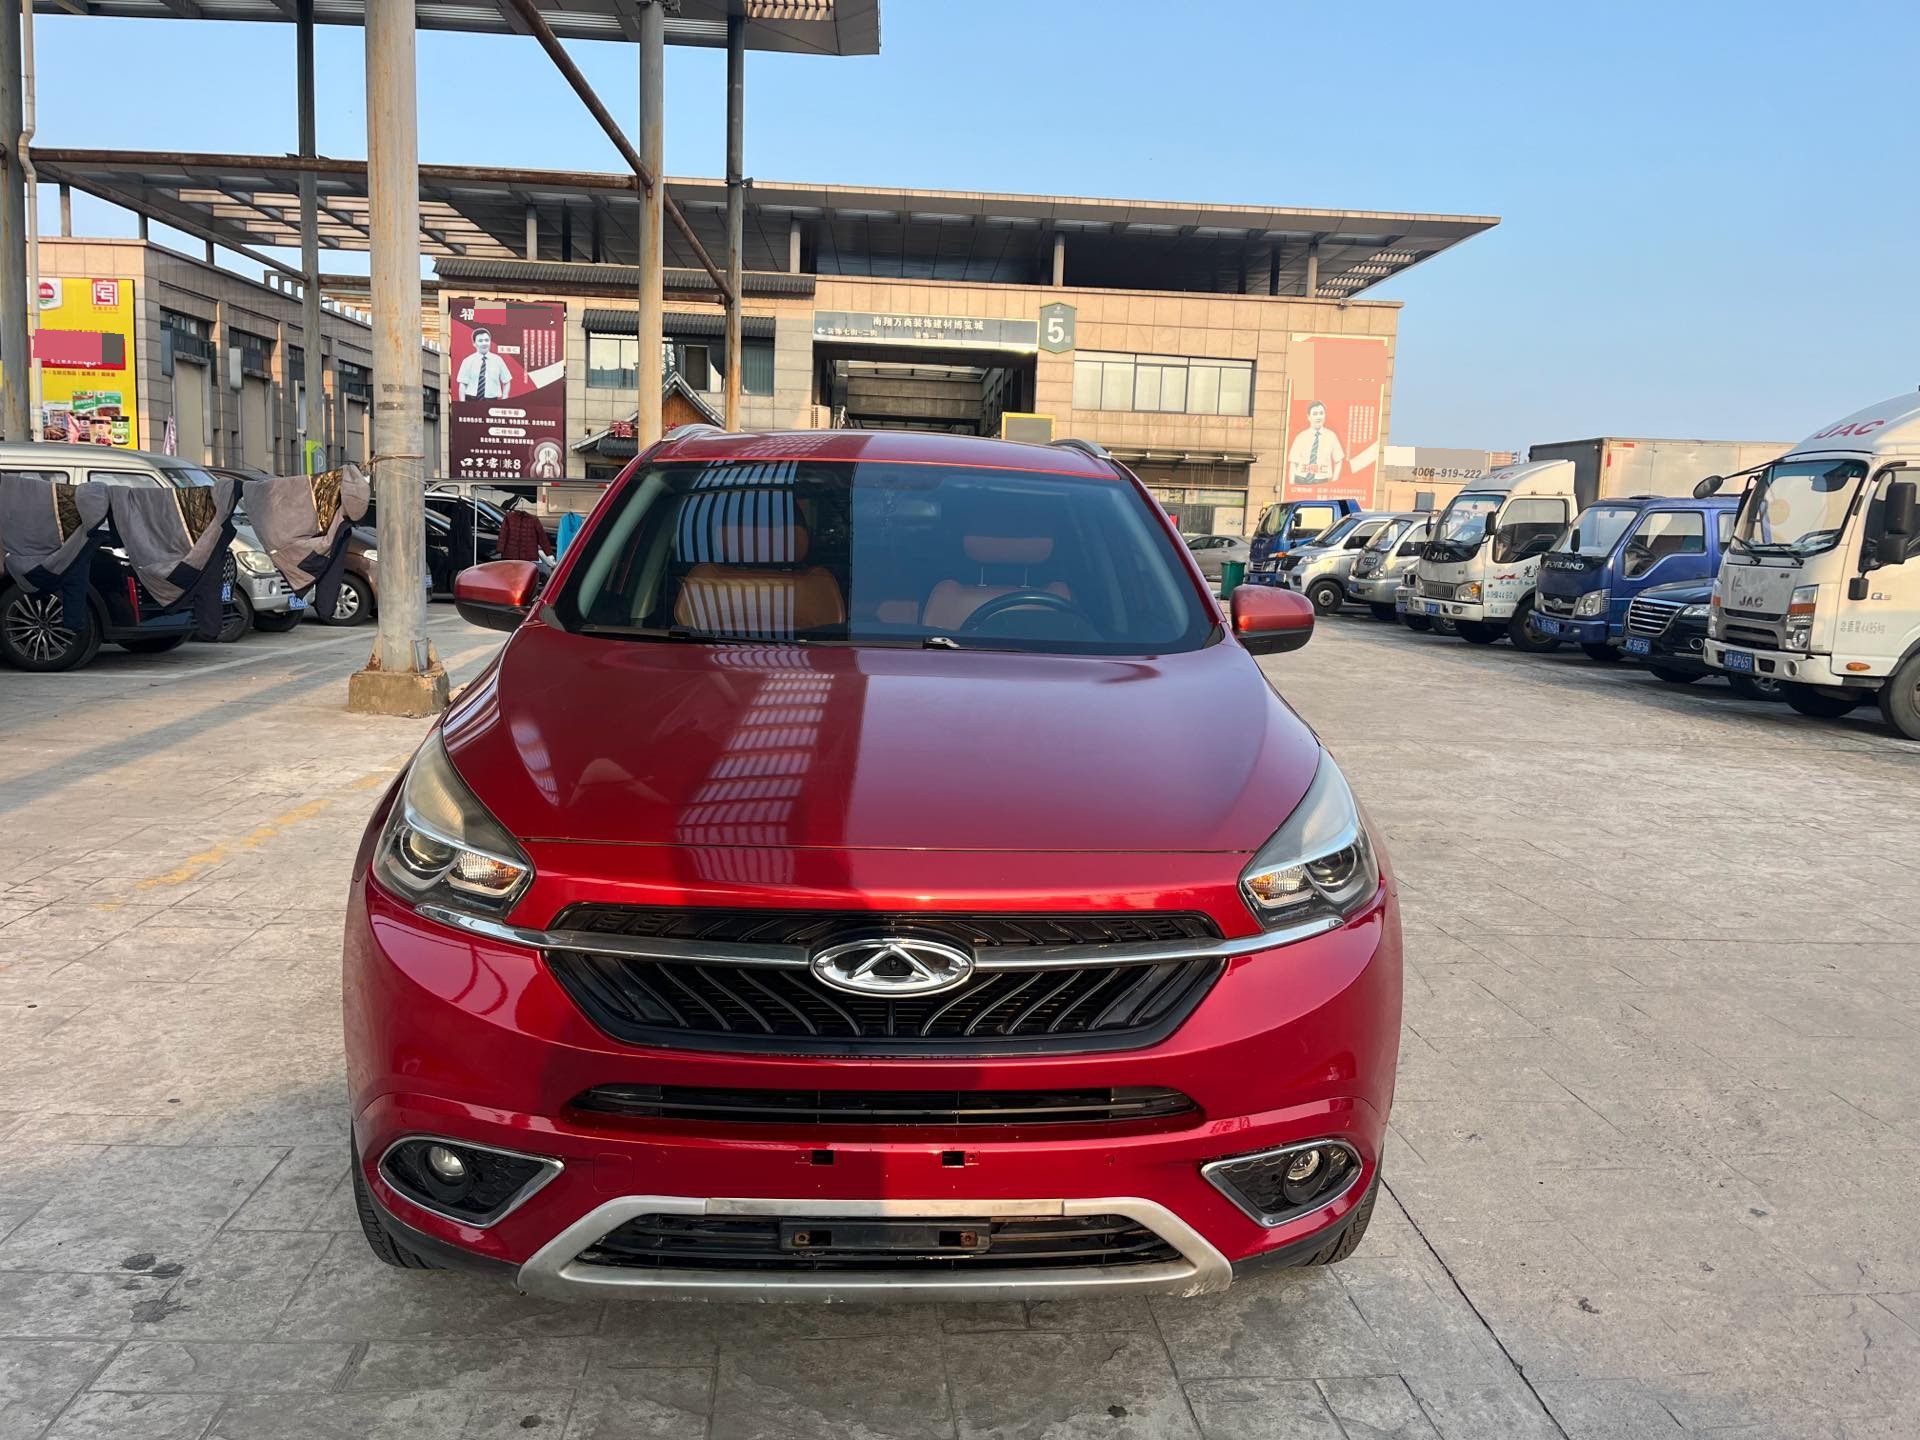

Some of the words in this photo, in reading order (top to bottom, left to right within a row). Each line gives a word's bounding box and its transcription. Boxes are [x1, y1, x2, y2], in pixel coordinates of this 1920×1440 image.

[1047, 317, 1065, 344] 5
[1813, 419, 1885, 440] JAC
[1411, 467, 1482, 479] 4006-919-222
[1431, 551, 1450, 561] JAC
[1544, 560, 1585, 571] FORLAND
[1738, 595, 1764, 608] JAC
